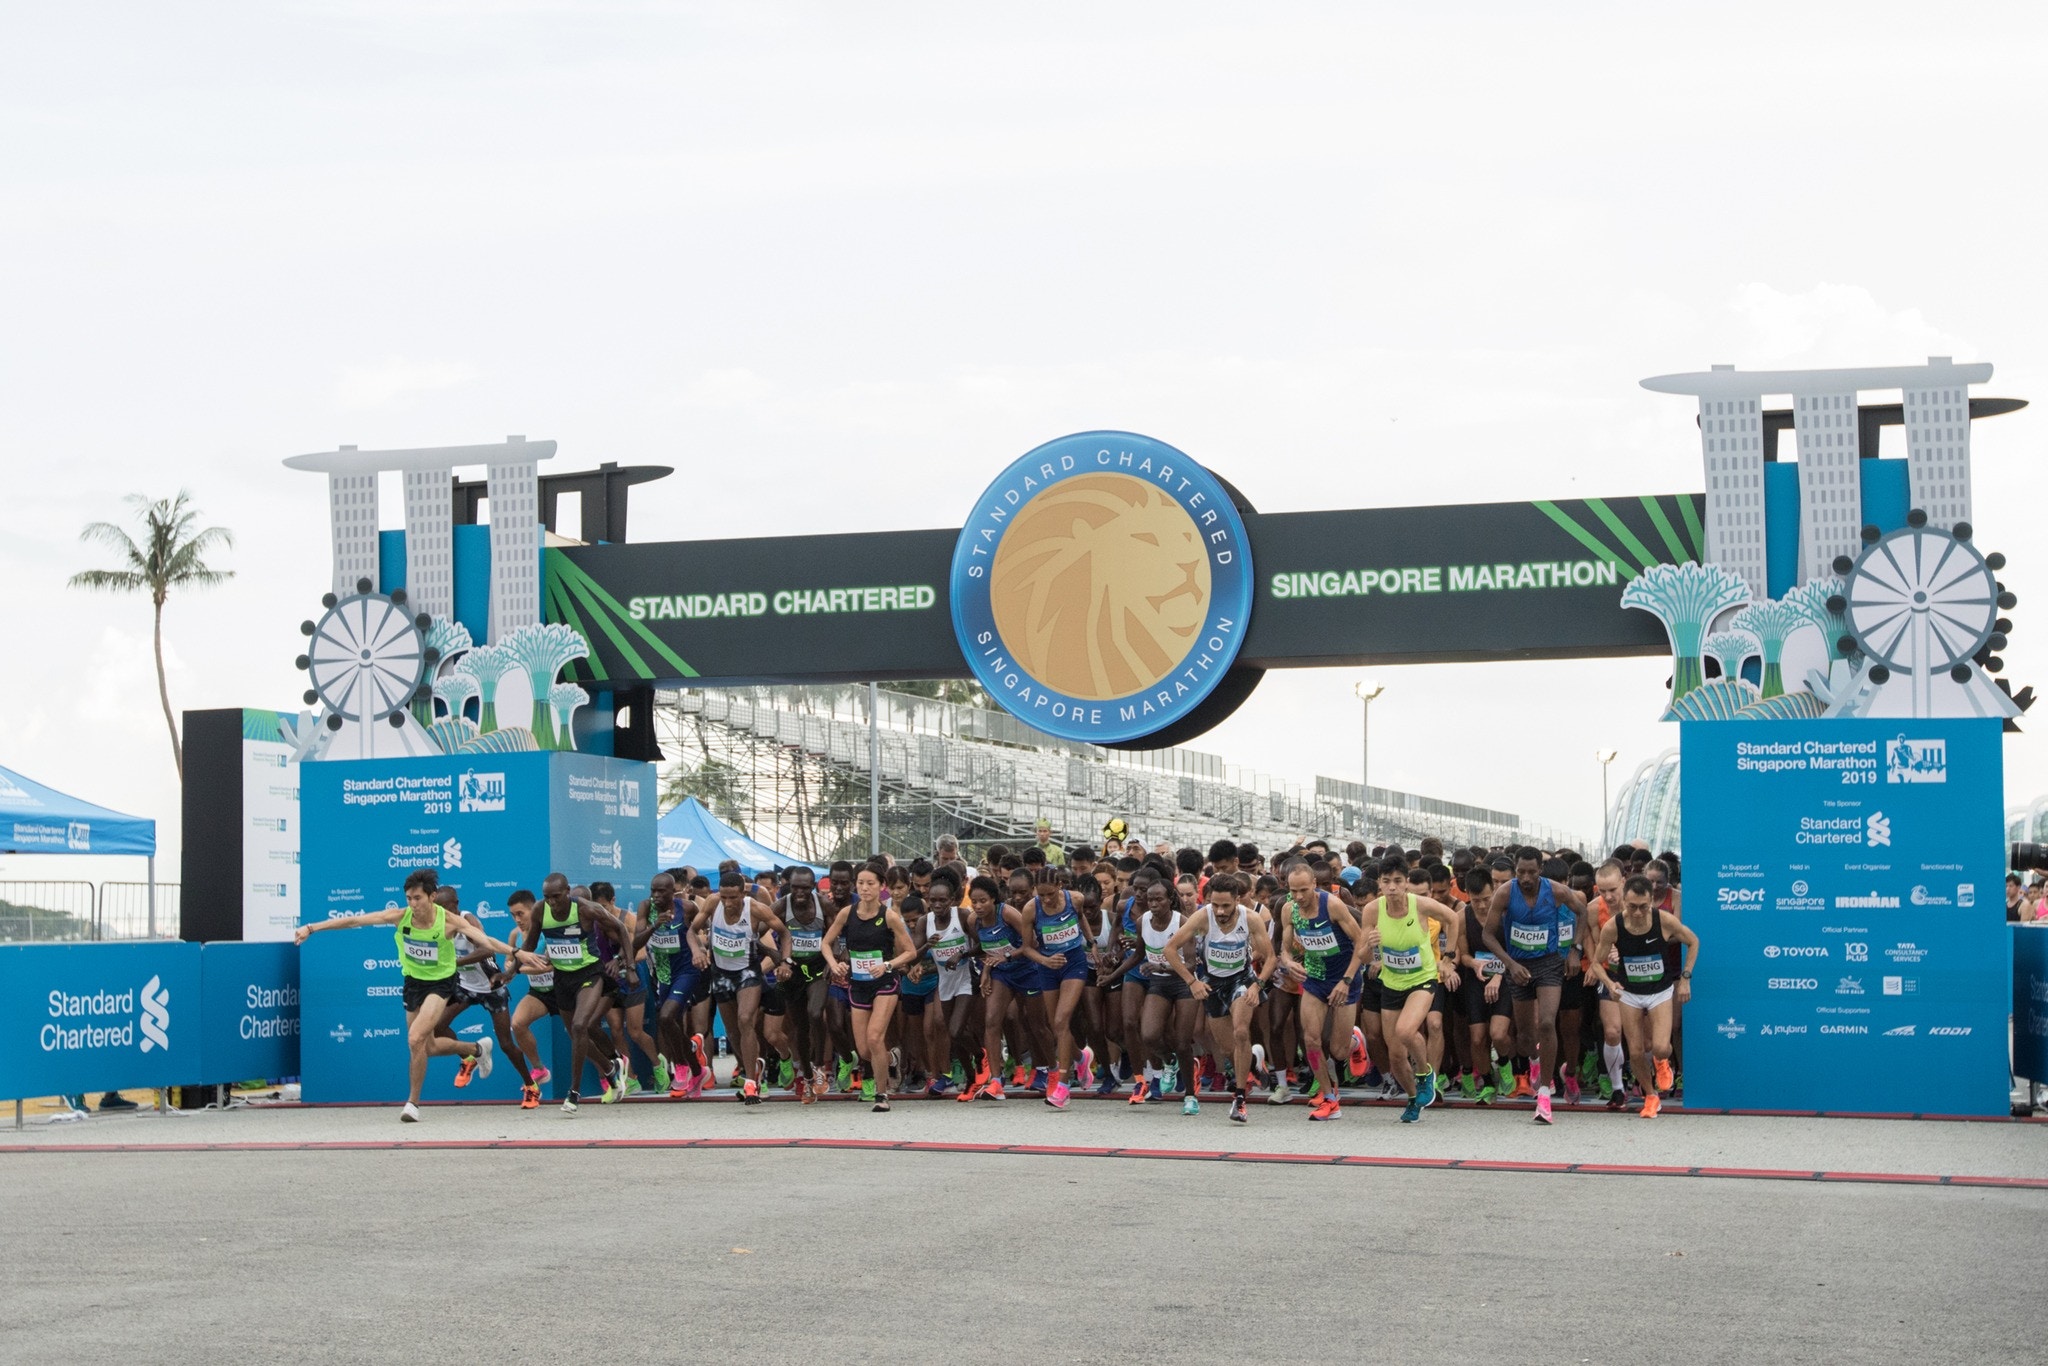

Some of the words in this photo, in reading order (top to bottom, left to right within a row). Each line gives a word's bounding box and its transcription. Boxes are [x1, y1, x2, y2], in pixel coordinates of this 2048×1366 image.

[968, 454, 1075, 578] STANDARD
[1097, 449, 1232, 565] CHARTERED
[1271, 567, 1441, 598] SINGAPORE
[1449, 561, 1617, 592] MARATHON
[629, 591, 767, 621] STANDARD
[774, 585, 935, 614] CHARTERED
[977, 631, 1102, 724] SINGAPORE
[1120, 617, 1233, 722] MARATHON
[1737, 742, 1801, 755] Standard
[1803, 741, 1876, 754] Chartered
[1737, 757, 1807, 772] Singapore
[1810, 757, 1877, 769] Marathon
[343, 778, 394, 791] Standard
[395, 775, 452, 789] Chartered
[568, 774, 592, 788] Standard
[593, 777, 617, 789] Chartered
[1841, 771, 1877, 784] 2019
[343, 792, 397, 806] Singapore
[400, 789, 452, 802] Marathon
[568, 788, 594, 802] Singapore
[594, 791, 617, 803] Marathon
[424, 802, 452, 814] 2019
[1836, 800, 1861, 808] Sponsor
[1800, 817, 1861, 830] Standard
[1795, 832, 1861, 844] Chartered
[392, 843, 439, 855] Standard
[388, 856, 439, 868] Chartered
[1728, 864, 1752, 872] Support
[1862, 863, 1891, 871] Organiser
[1955, 863, 1963, 872] by
[1717, 887, 1765, 904] Sport
[1835, 891, 1900, 908] IRONMAN
[1721, 903, 1762, 911] SINGAPORE
[1045, 927, 1077, 942] DASKA
[1303, 935, 1333, 946] CHANI
[1513, 929, 1545, 941] BACHA
[715, 935, 744, 948] TSEGAY
[408, 946, 432, 957] SOH
[550, 945, 579, 955] KIRUI
[1782, 947, 1829, 957] TOYOTA
[1845, 942, 1868, 954] 100
[378, 960, 401, 968] TOYO
[1387, 955, 1416, 966] LIEW
[1628, 962, 1660, 972] CHENG
[1768, 978, 1818, 990] SEIKO
[48, 987, 133, 1018] Standard
[1837, 1007, 1870, 1015] Supporters
[240, 1015, 300, 1040] Chartere
[1820, 1025, 1868, 1034] GARMIN
[1928, 1027, 1972, 1035] KODA
[40, 1020, 133, 1051] Chartered
